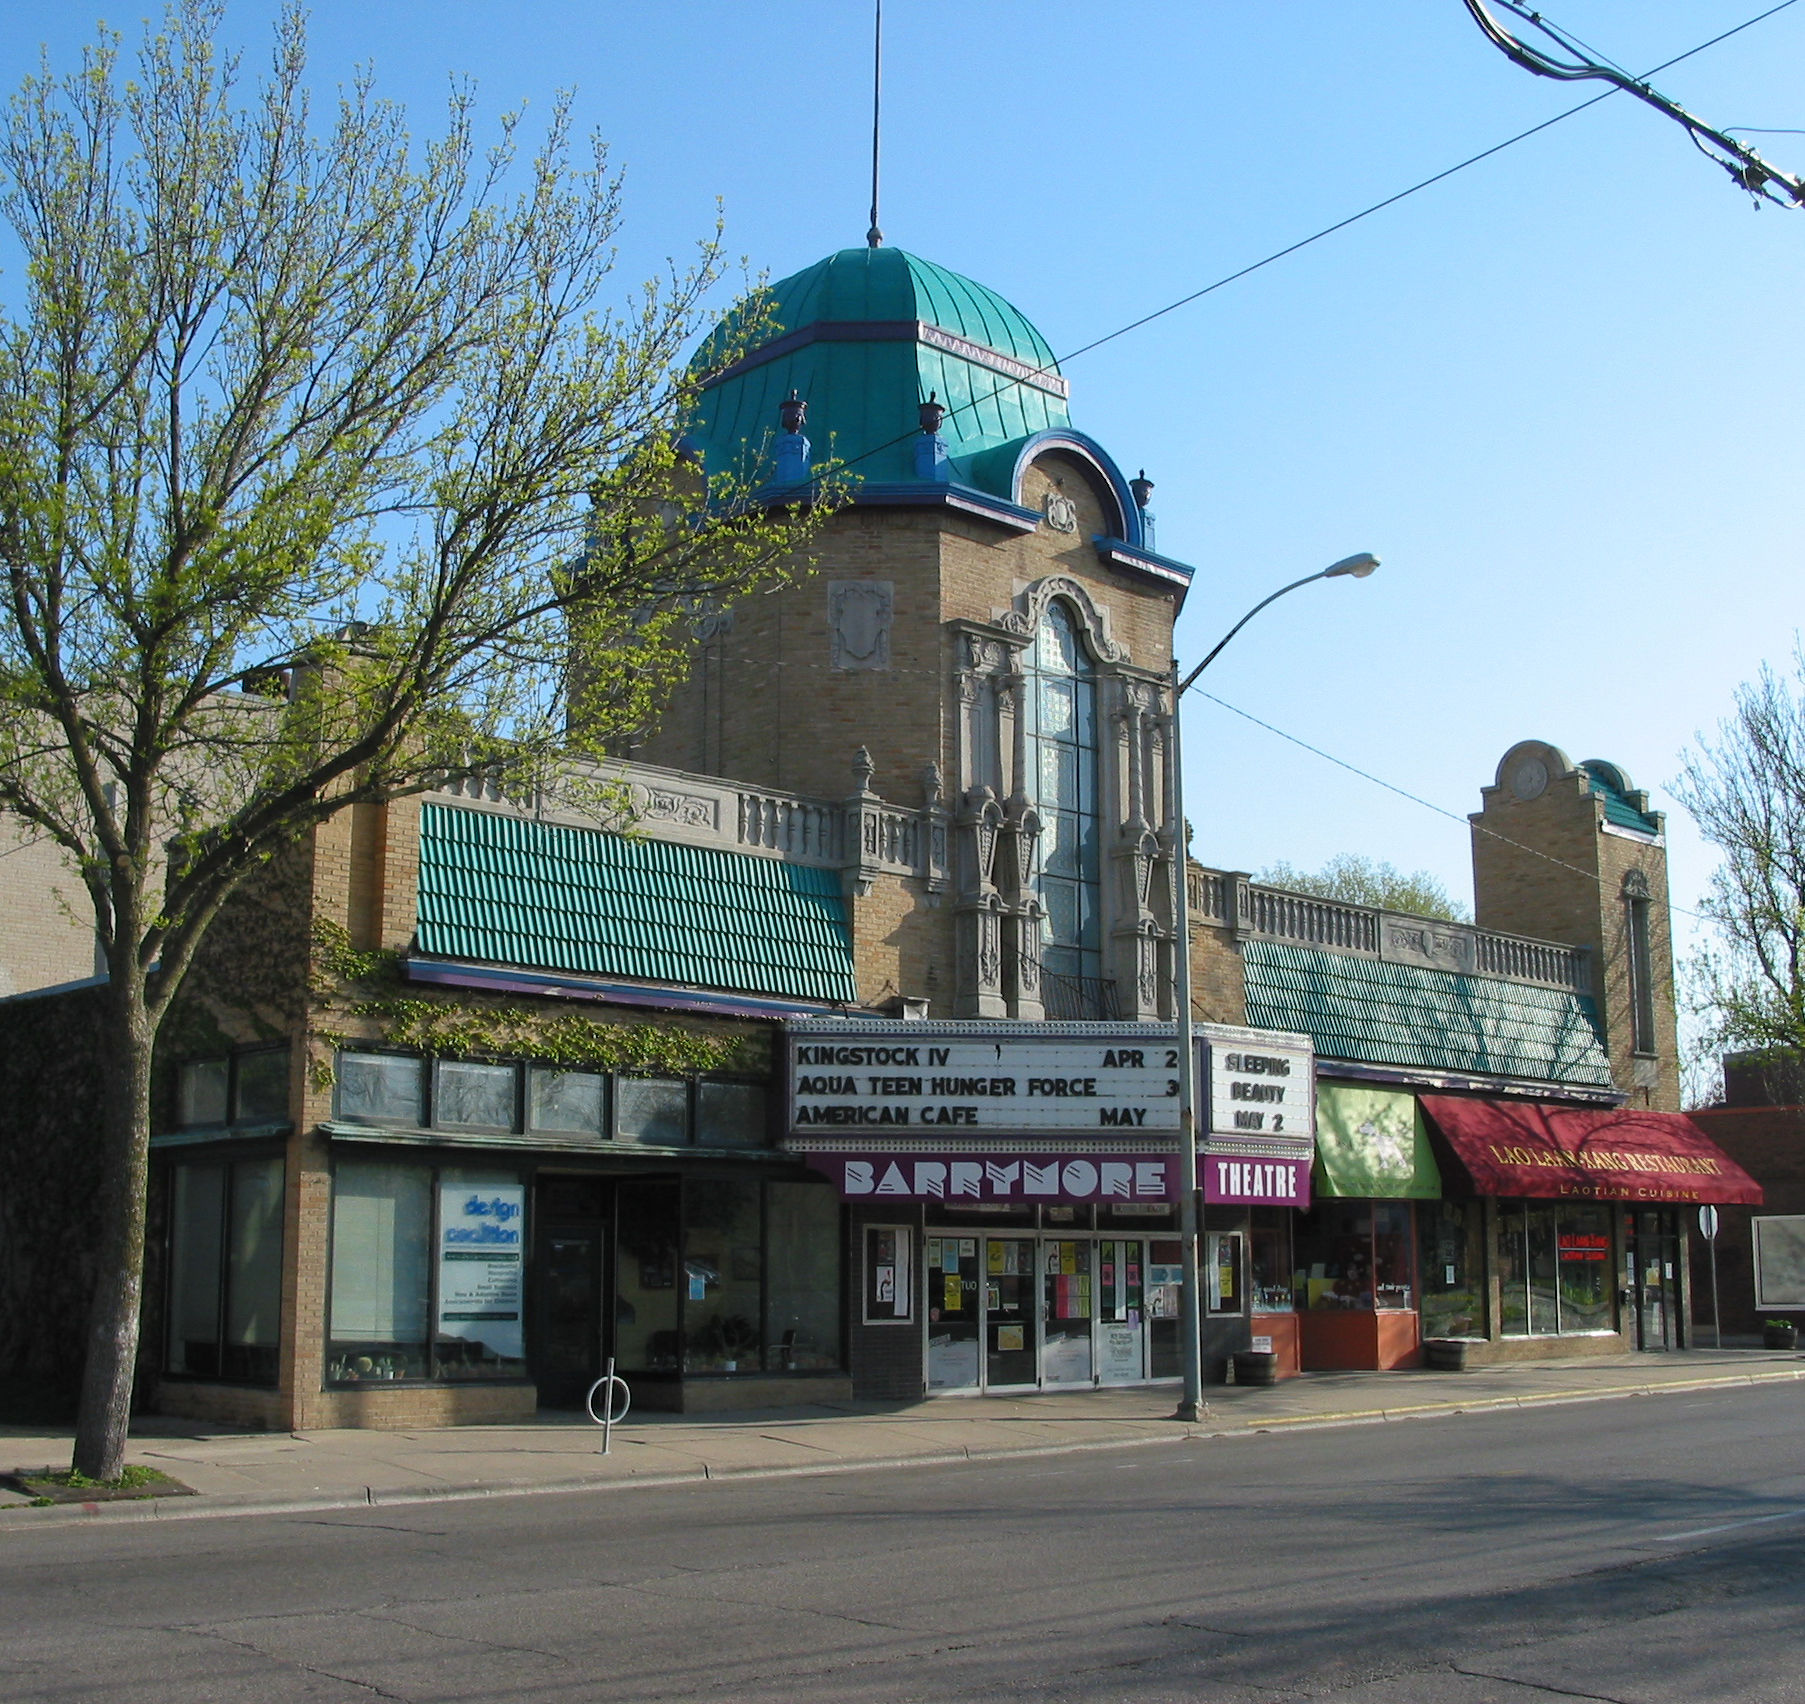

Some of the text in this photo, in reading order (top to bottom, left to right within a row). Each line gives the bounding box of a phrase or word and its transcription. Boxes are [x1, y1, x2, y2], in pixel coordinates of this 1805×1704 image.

[798, 1046, 950, 1067] KINGSTOCK IV
[1102, 1049, 1144, 1068] APR
[1225, 1053, 1290, 1077] SLEEPING
[798, 1076, 858, 1096] AQUA
[868, 1077, 922, 1096] TEEN
[931, 1077, 1016, 1097] HUNGER
[1028, 1078, 1097, 1097] FORCE
[1231, 1081, 1285, 1105] BEAUTY
[796, 1105, 1147, 1126] AMERICAN CAFE MAY
[1234, 1110, 1284, 1132] MAY 2
[1489, 1145, 1531, 1167] LAO
[1624, 1153, 1723, 1176] RESTAURANT
[845, 1160, 1166, 1199] BARRYMORE
[1218, 1162, 1297, 1198] THEATRE
[464, 1195, 520, 1222] design
